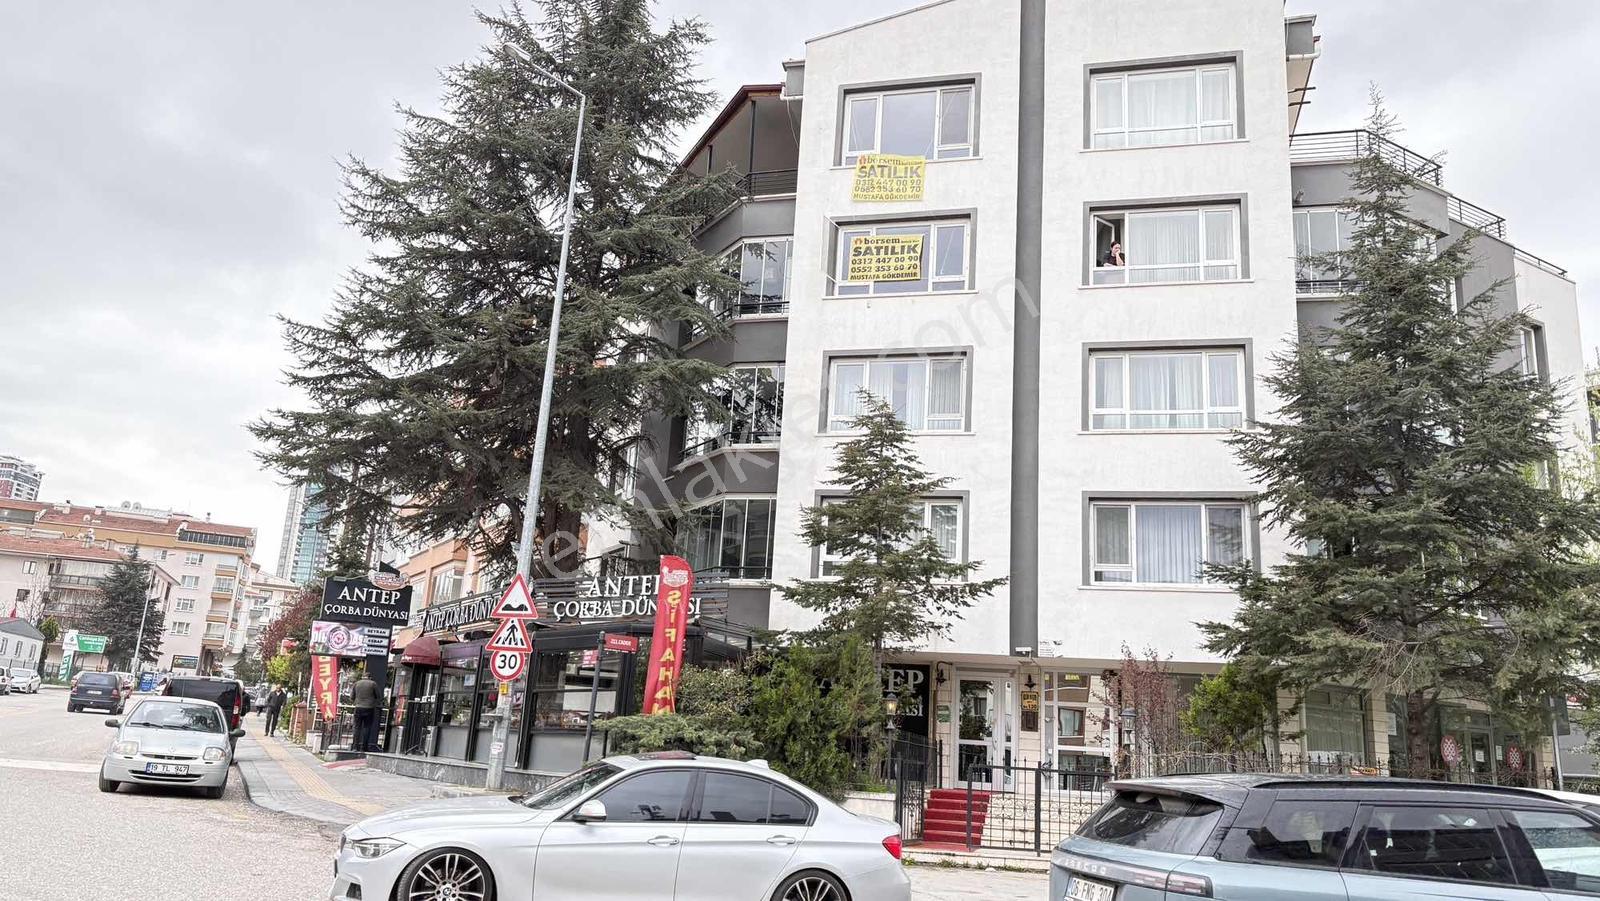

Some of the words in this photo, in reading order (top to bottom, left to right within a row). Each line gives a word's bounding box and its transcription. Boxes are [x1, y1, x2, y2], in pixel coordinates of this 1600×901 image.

[857, 165, 922, 178] SATILIK
[864, 237, 901, 245] borsem
[852, 244, 920, 257] SATILIK
[850, 265, 873, 273] 0552
[337, 585, 400, 605] ANTEP
[324, 603, 361, 615] ÇORBA
[363, 606, 409, 620] DÜNYASI
[553, 600, 614, 622] ÇORBA
[621, 595, 701, 617] DÜNSI
[498, 654, 518, 669] 30
